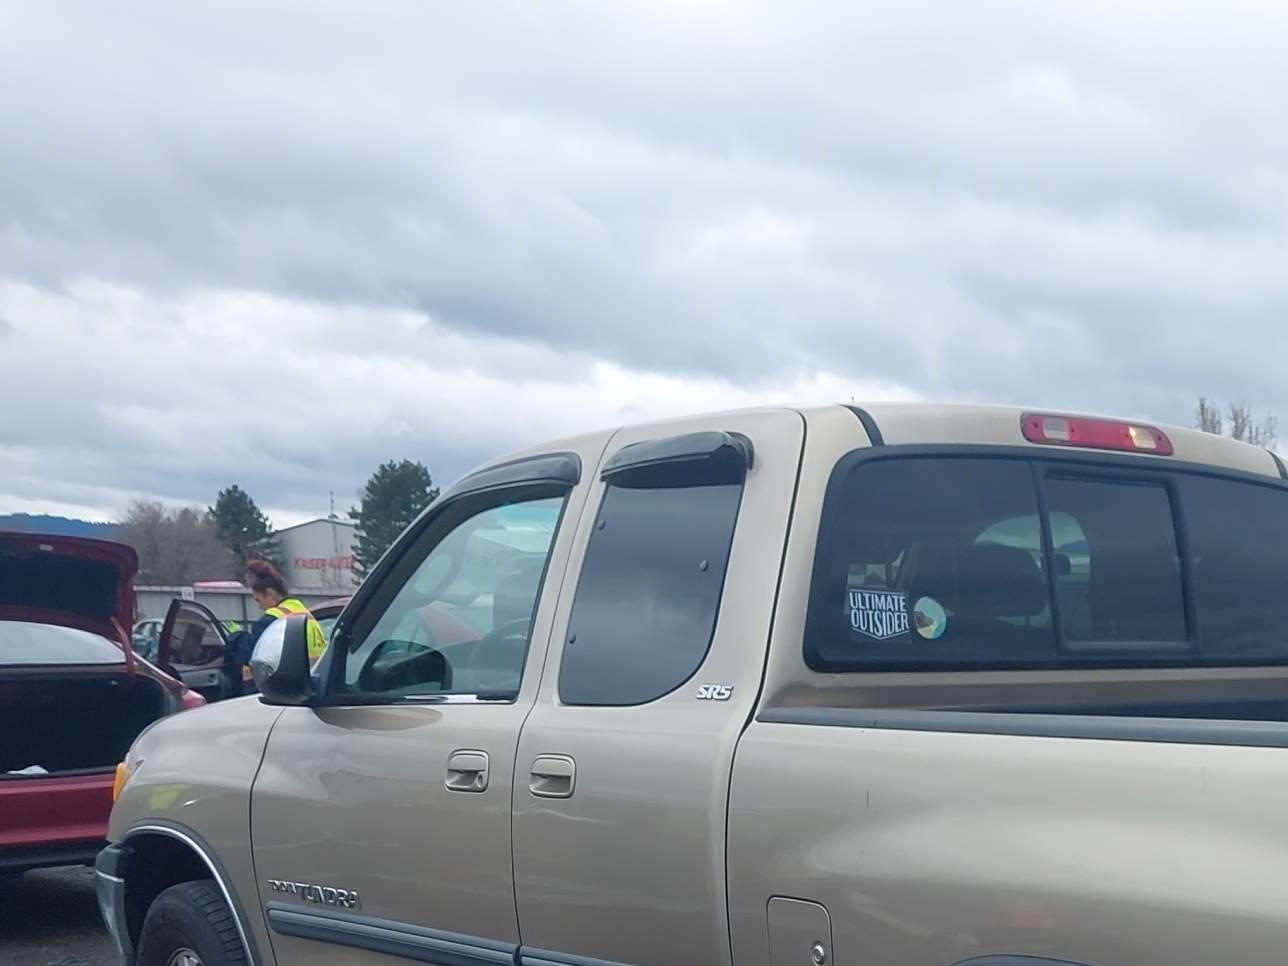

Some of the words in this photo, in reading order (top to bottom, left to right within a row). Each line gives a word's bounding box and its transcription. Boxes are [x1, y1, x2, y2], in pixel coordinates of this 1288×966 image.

[849, 592, 907, 612] ULTIMATE
[850, 609, 910, 636] OUTSIDER
[696, 684, 734, 701] SR5
